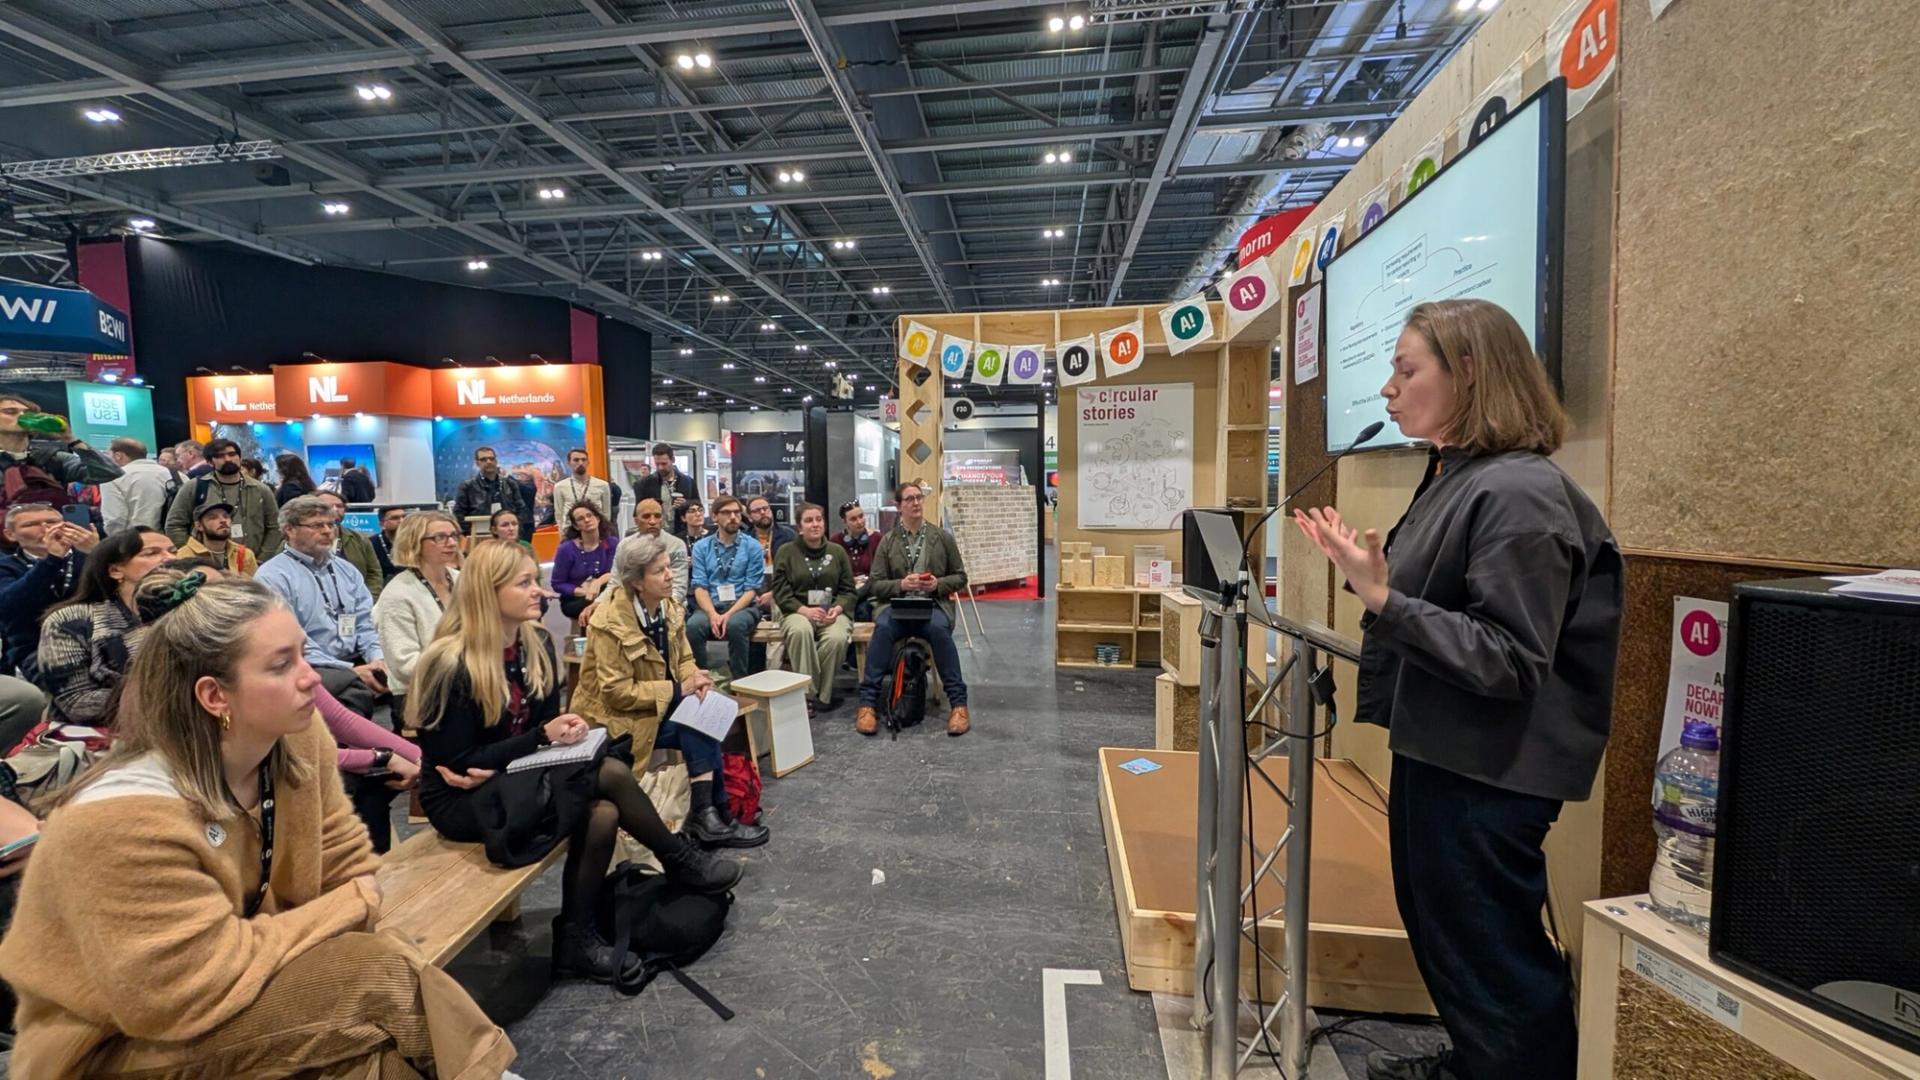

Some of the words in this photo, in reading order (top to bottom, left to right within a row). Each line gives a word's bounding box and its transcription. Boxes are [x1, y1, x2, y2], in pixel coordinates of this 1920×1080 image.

[1577, 8, 1608, 71] A!
[1240, 282, 1258, 304] A!
[99, 310, 125, 342] BEWI
[1180, 313, 1196, 333] A!
[1118, 339, 1131, 357] A!
[947, 353, 959, 365] A!
[983, 358, 995, 371] A!
[1020, 357, 1032, 372] A!
[1070, 352, 1082, 370] A!
[309, 376, 349, 403] NL
[457, 379, 496, 405] NL
[499, 393, 555, 404] Netherlands
[91, 397, 119, 410] USE
[214, 387, 247, 412] NL
[885, 403, 896, 414] 20
[1083, 404, 1135, 420] stories
[1046, 436, 1055, 449] 4
[1690, 621, 1709, 645] A!
[1685, 697, 1719, 720] NOW!
